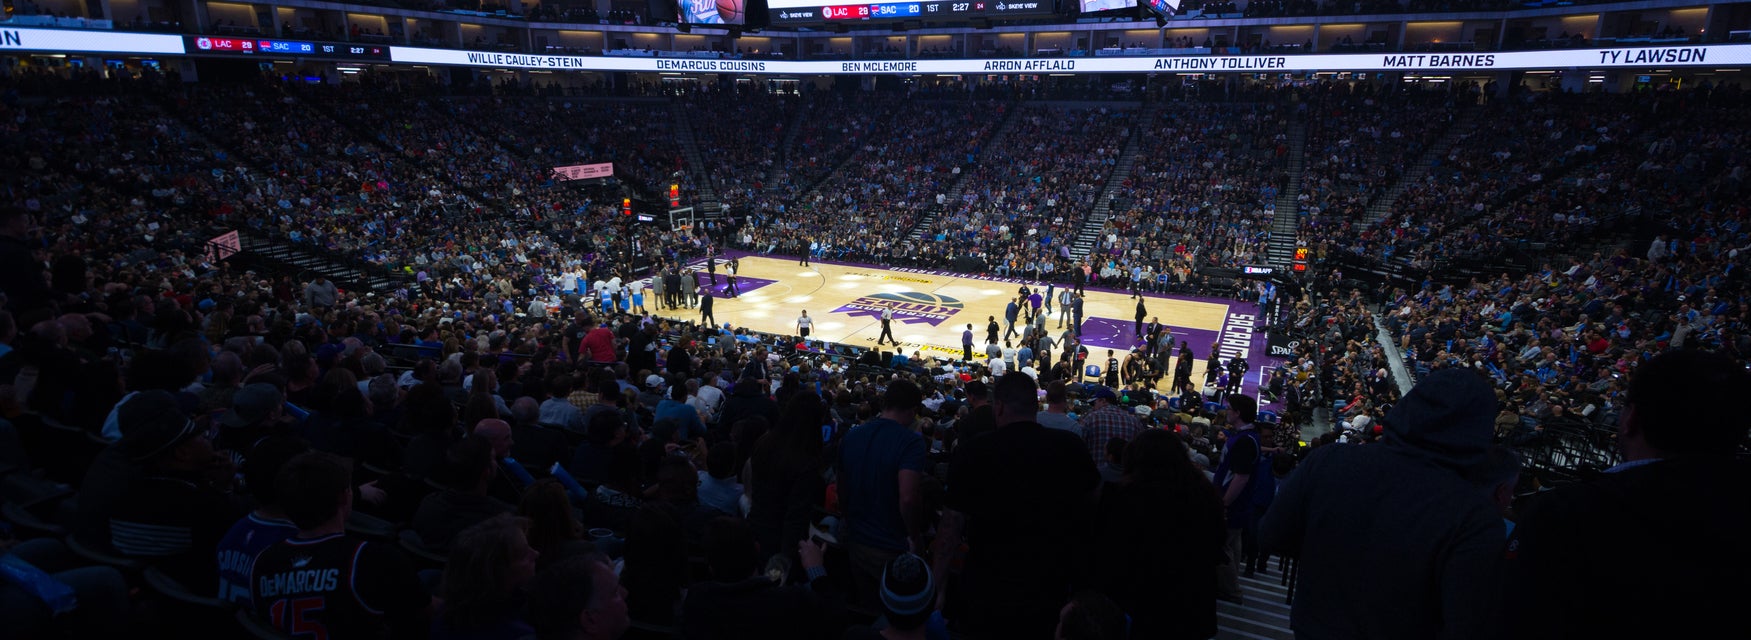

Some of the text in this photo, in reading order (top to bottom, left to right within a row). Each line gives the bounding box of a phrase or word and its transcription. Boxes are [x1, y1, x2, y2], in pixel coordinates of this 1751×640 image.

[881, 6, 896, 14] SAC
[908, 5, 919, 13] 20
[952, 3, 969, 11] 2:27
[0, 30, 22, 46] N
[214, 40, 232, 48] LAC
[323, 45, 334, 53] 1ST
[467, 53, 583, 67] WILLIE CAULEY-STEIN
[1383, 54, 1495, 67] MATT BARNES
[1599, 48, 1707, 64] TY LAWSON
[656, 60, 766, 71] DEMARCUS COUSINS
[842, 62, 917, 72] BEN MCLEMORE
[983, 60, 1075, 70] ARRON AFFLALO
[1154, 57, 1286, 69] ANTHONY TOLLIVER
[889, 266, 937, 275] PROUD
[845, 304, 947, 320] SACRAENTO
[851, 297, 961, 315] KINGS
[270, 594, 329, 640] 15
